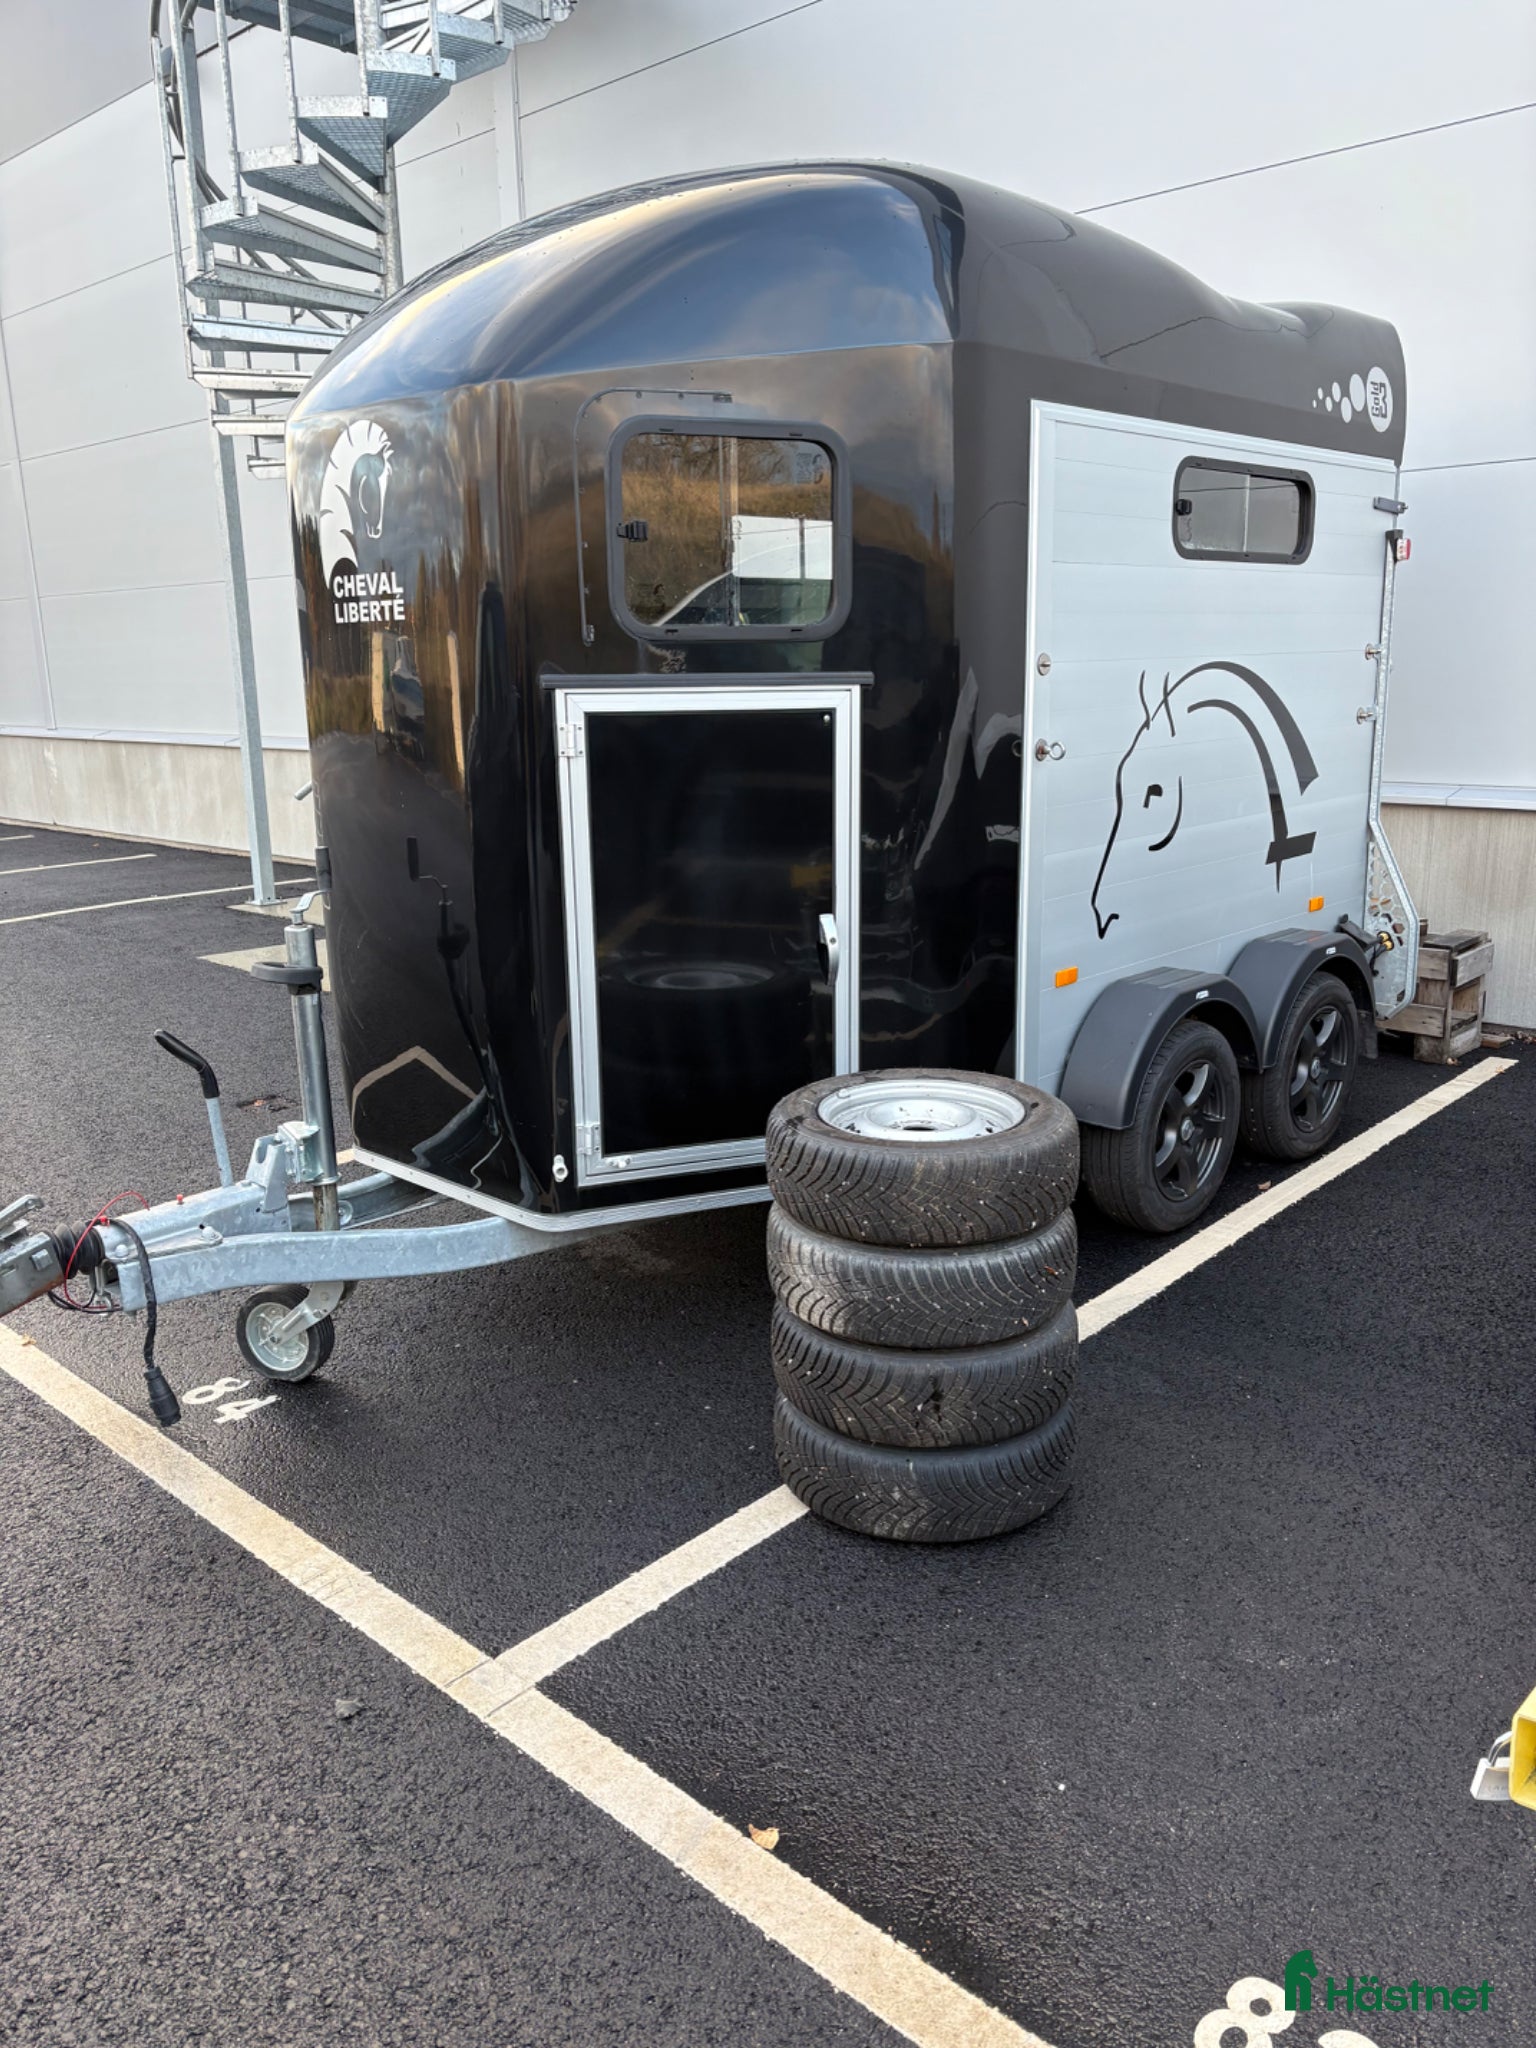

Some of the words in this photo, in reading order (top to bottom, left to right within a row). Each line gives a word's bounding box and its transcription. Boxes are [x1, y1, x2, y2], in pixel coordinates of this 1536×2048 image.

[333, 571, 404, 598] CHEVAL
[334, 594, 405, 624] LIBERTÉ
[181, 1377, 281, 1423] 84
